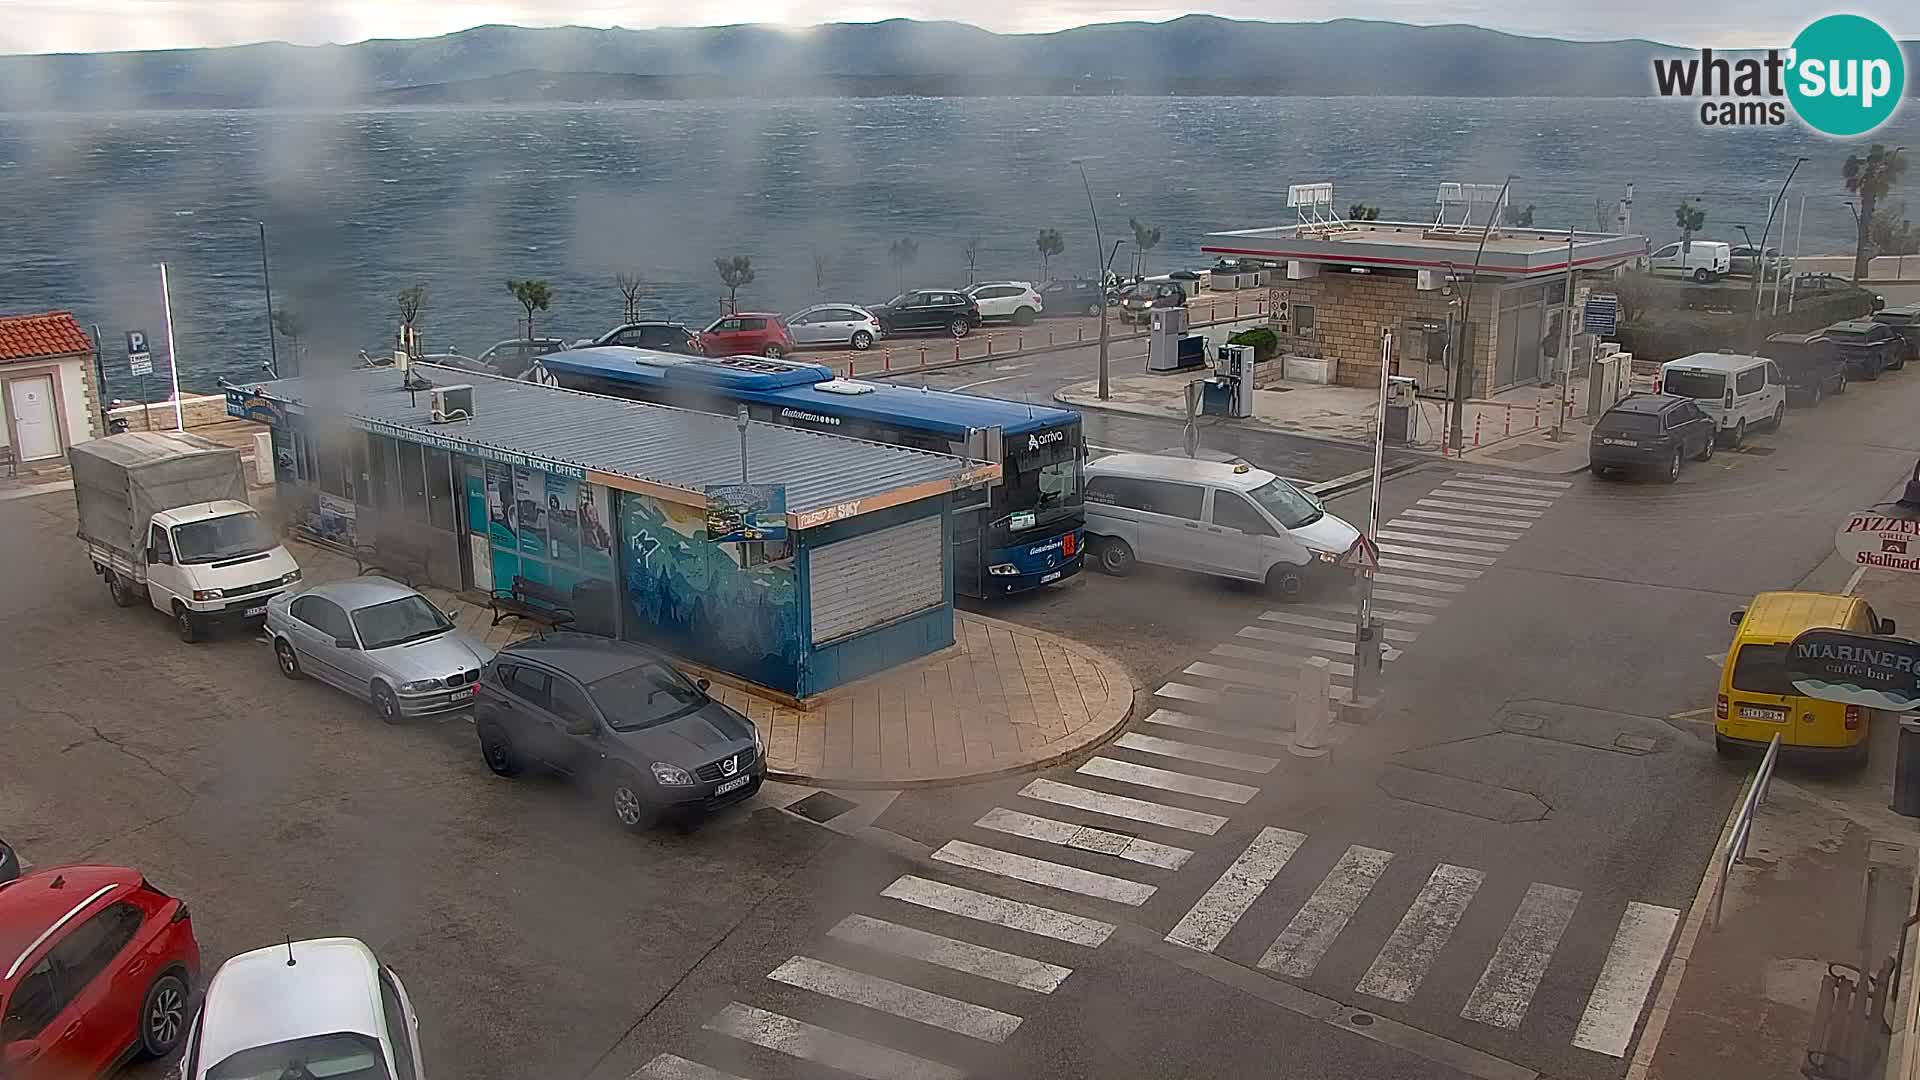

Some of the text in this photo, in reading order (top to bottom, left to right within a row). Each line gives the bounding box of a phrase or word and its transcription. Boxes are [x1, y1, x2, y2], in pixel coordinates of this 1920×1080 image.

[131, 332, 143, 351] P
[781, 407, 820, 422] Autotrans
[1038, 430, 1063, 445] arriva
[396, 429, 436, 446] AUTOBUSNA
[437, 438, 467, 452] POSTAJA
[479, 447, 493, 459] BUS
[494, 452, 526, 466] STATION
[527, 458, 554, 473] TICKET
[555, 464, 582, 478] OFFICE
[1879, 531, 1913, 542] GRILL
[1825, 663, 1894, 681] caffe bar
